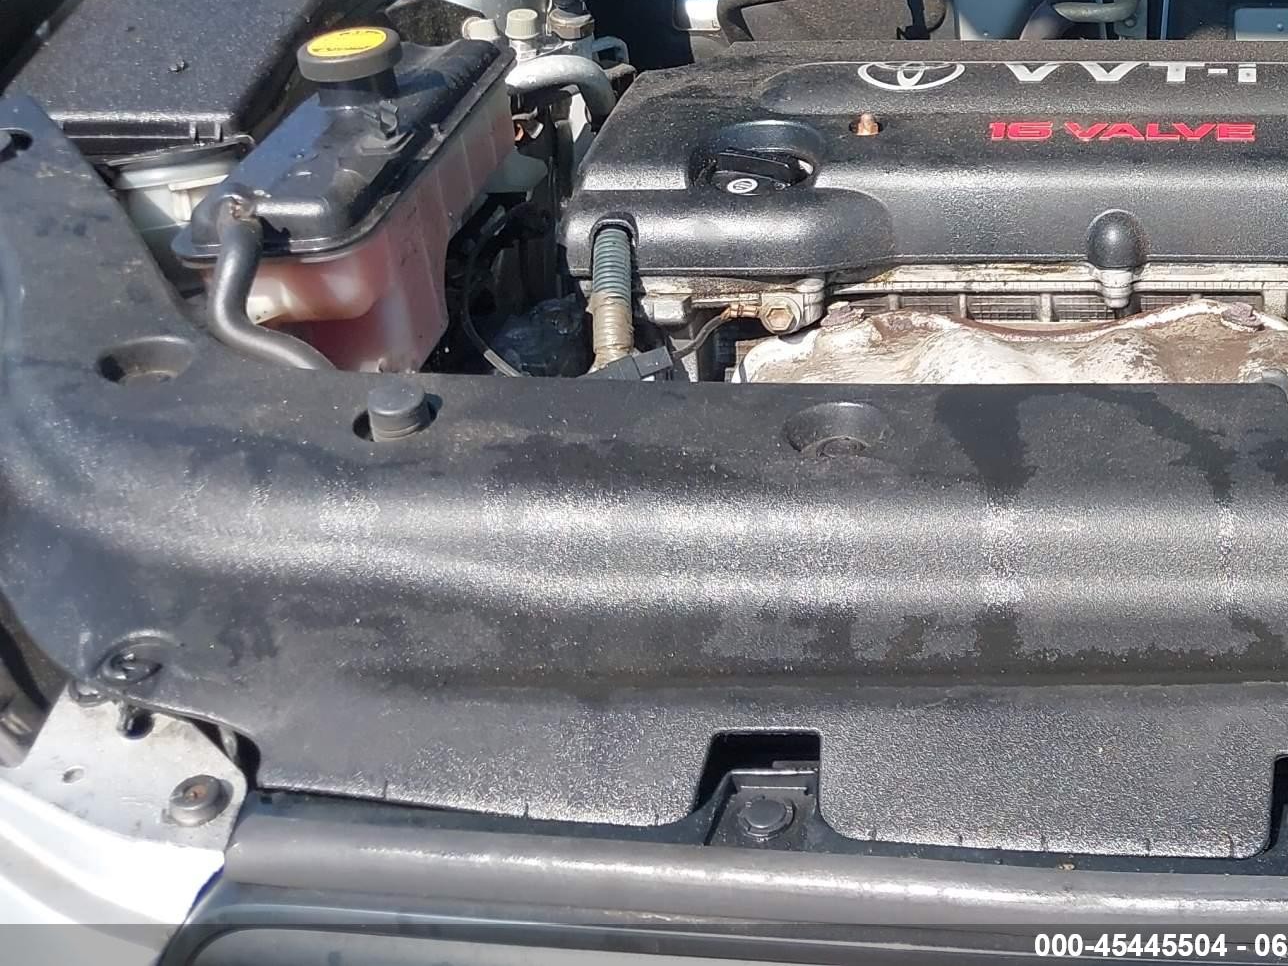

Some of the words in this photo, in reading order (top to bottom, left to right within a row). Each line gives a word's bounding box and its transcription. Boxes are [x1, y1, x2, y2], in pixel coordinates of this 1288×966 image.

[1004, 61, 1256, 82] VVT-i
[990, 122, 1053, 141] 16
[1064, 122, 1255, 141] VALVE
